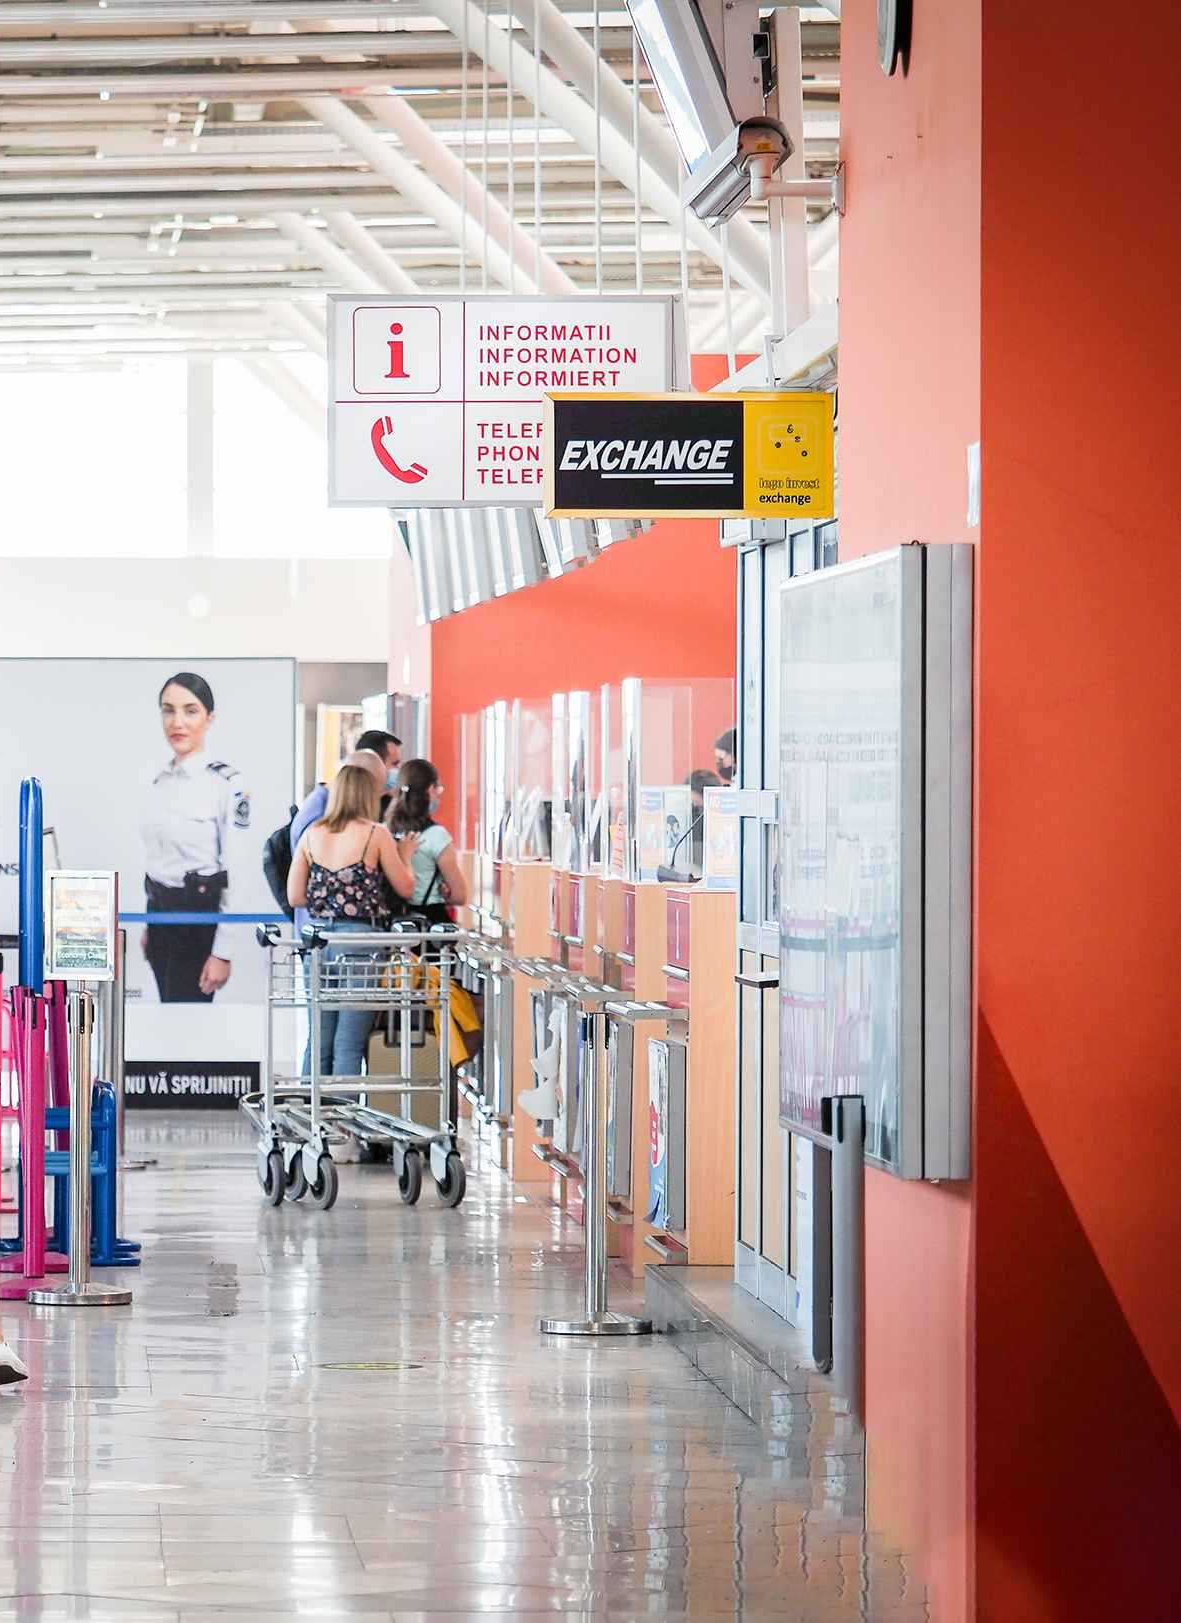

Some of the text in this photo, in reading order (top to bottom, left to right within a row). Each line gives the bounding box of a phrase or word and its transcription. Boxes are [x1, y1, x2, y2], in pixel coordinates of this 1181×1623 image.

[479, 325, 611, 341] INFORMATII
[479, 347, 637, 363] INFORMATION
[479, 370, 621, 386] INFORMIERT
[558, 439, 734, 471] EXCHANGE
[758, 492, 812, 506] exchange
[124, 1075, 146, 1095] NU
[148, 1071, 169, 1095] VĂ
